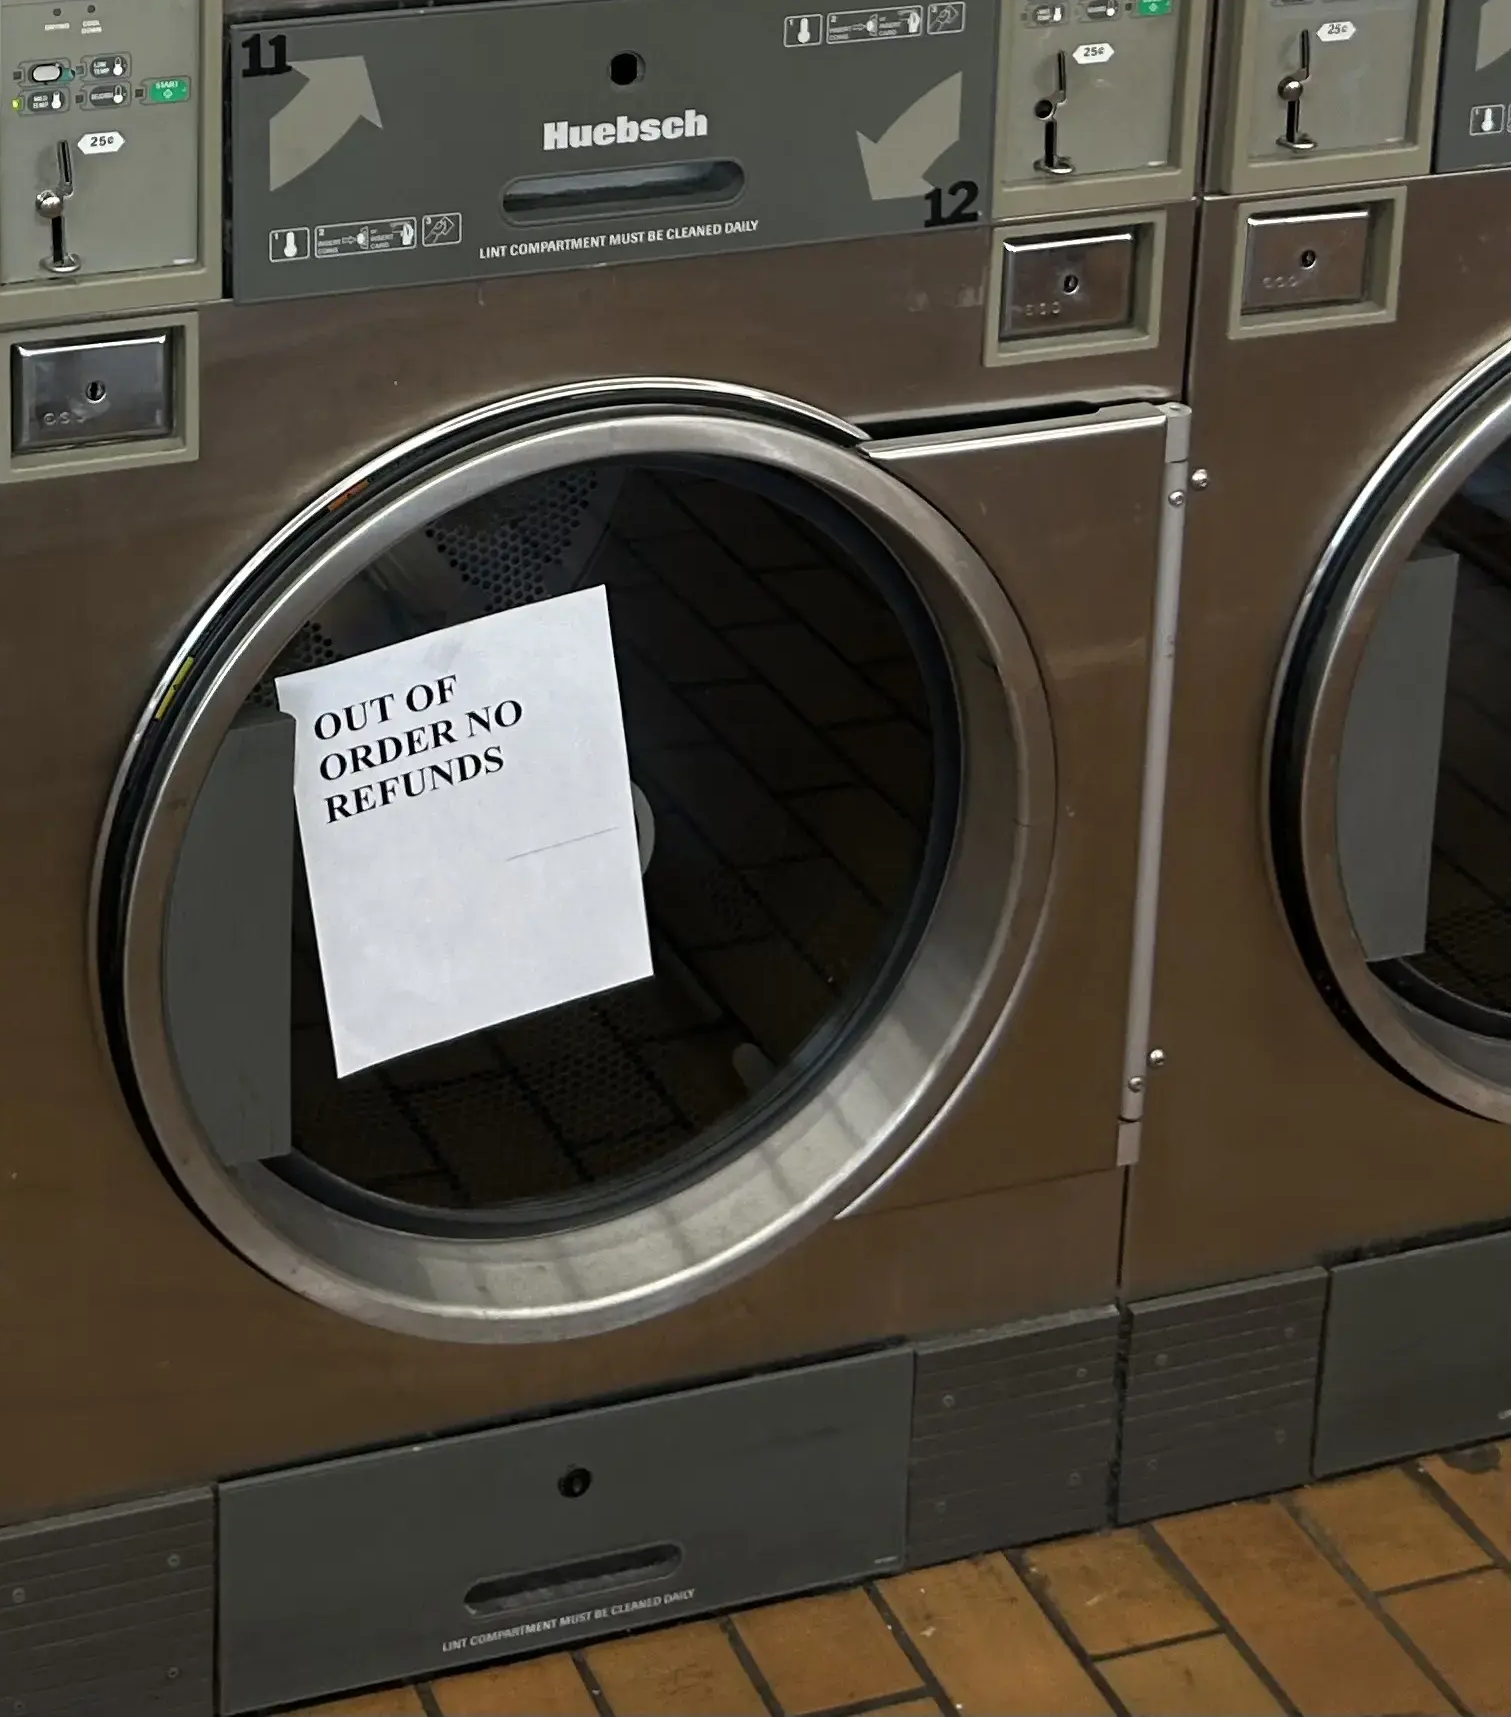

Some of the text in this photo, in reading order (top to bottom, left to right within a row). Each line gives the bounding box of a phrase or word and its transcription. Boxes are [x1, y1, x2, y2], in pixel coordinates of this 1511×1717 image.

[241, 33, 292, 78] 11
[1084, 46, 1104, 57] 25¢
[90, 136, 114, 147] 25¢
[543, 109, 708, 151] Huebsch
[922, 179, 980, 228] 12
[479, 219, 759, 259] LINT COMPARTMENT MUST BE CLEANED DAILY
[314, 674, 457, 741] OUT OF
[318, 700, 523, 783] ORDER NO
[322, 745, 506, 826] REFUNDS
[442, 1588, 695, 1653] LINT COMPARTMENT MUST BE CLEANED DAILY
